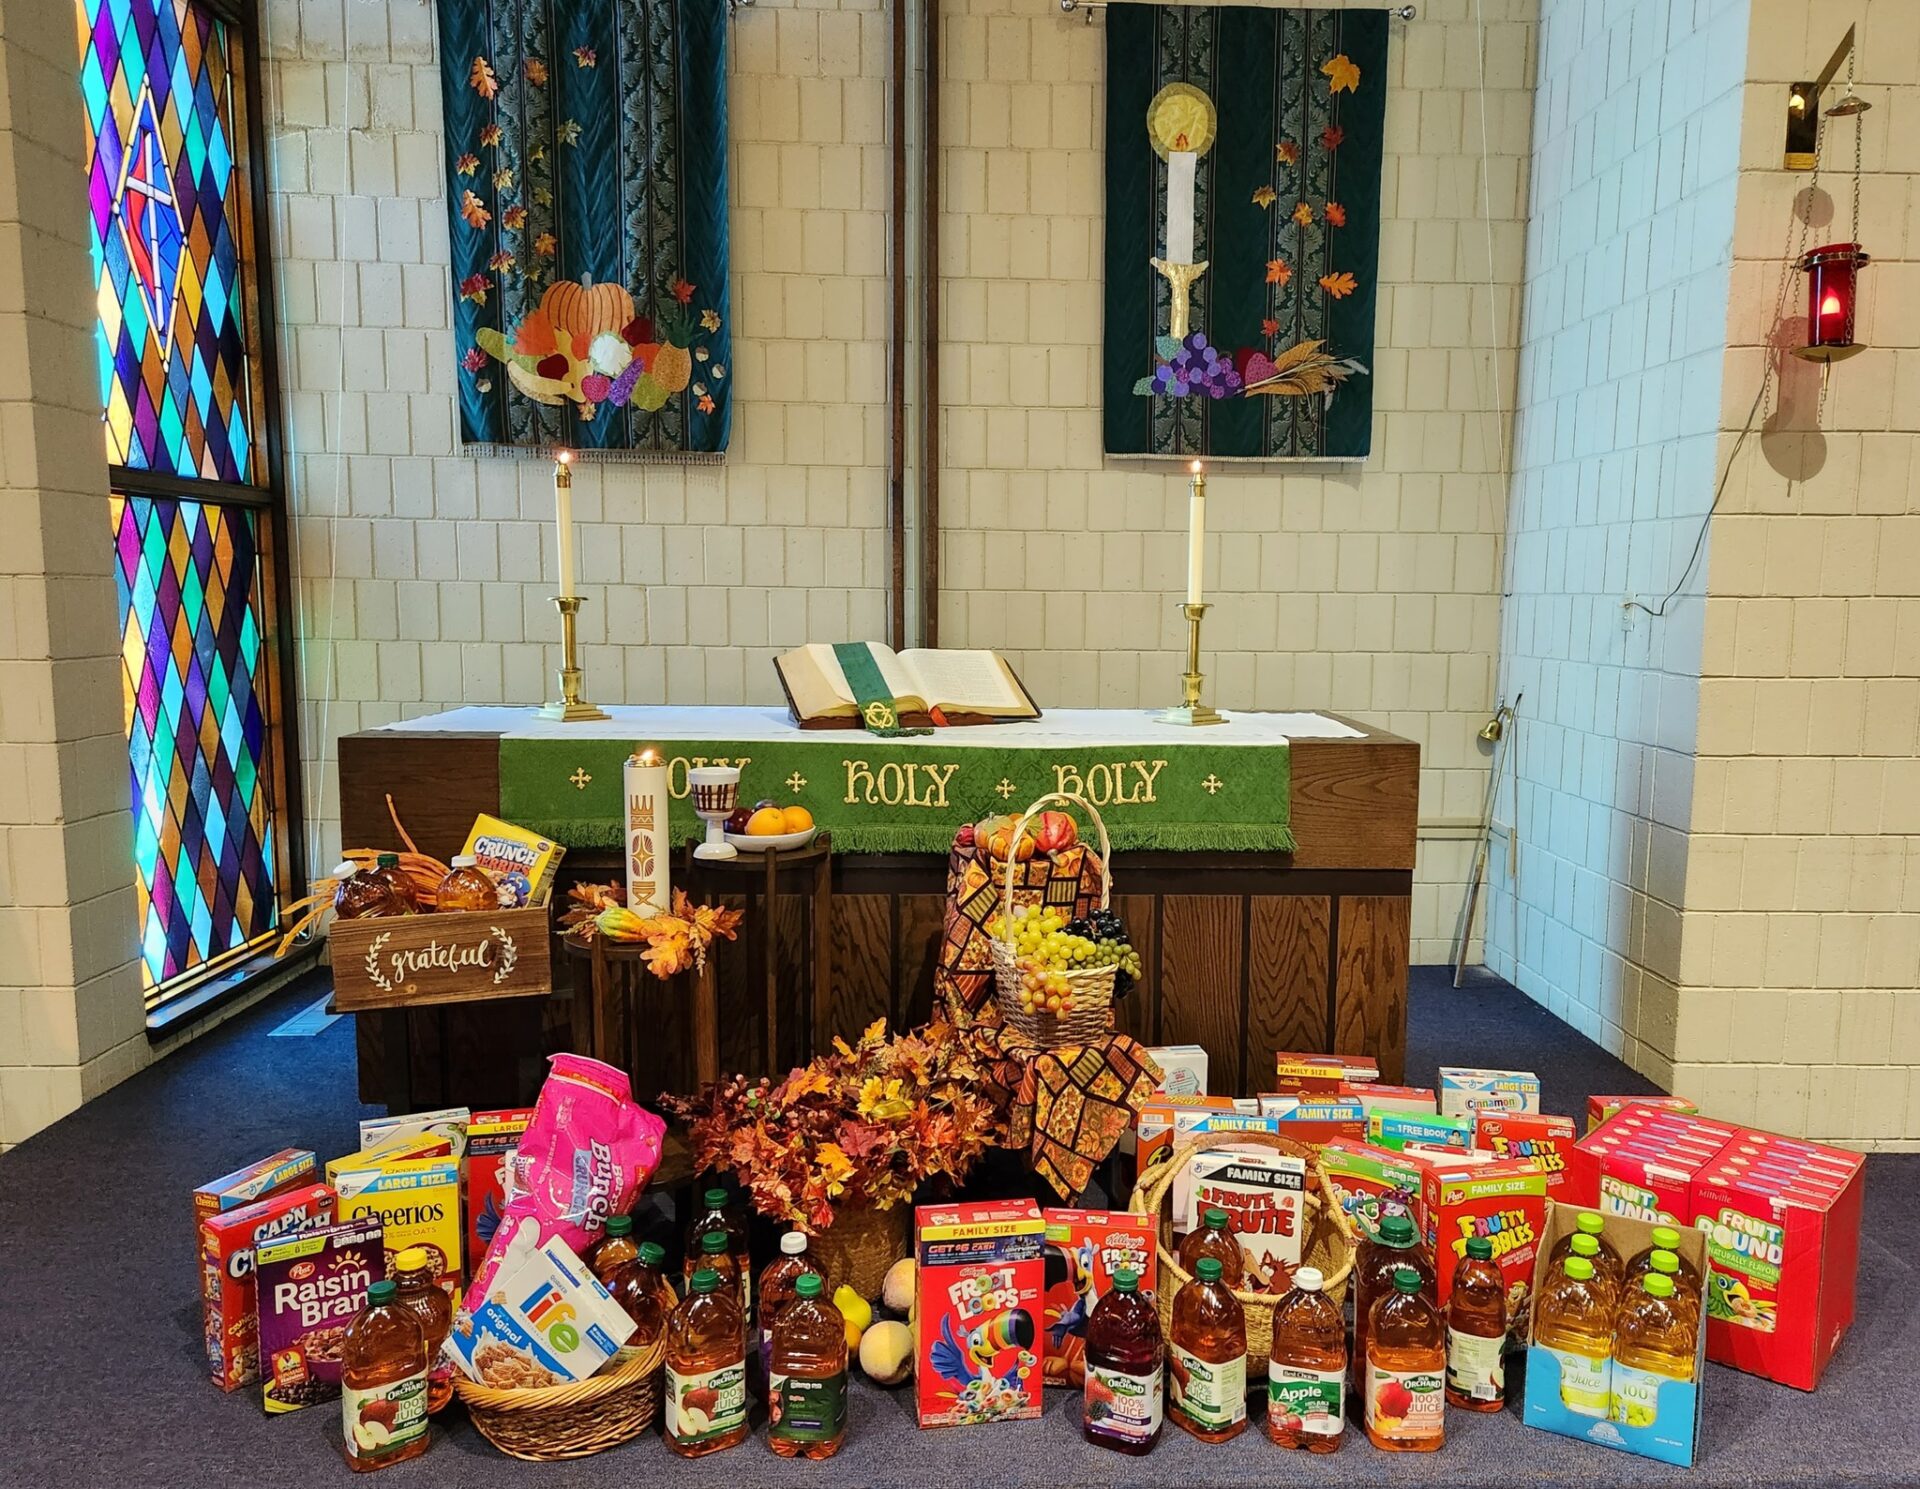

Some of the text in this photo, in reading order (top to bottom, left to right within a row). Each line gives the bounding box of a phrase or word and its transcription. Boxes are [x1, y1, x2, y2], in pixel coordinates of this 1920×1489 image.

[842, 760, 959, 808] HOLY
[474, 837, 540, 867] CRUNCH
[391, 939, 492, 983] grateful
[1280, 1066, 1327, 1076] FAMILY SIZE
[1494, 1081, 1518, 1091] LARGE
[1520, 1082, 1537, 1092] SIZE
[1466, 1097, 1515, 1109] Cinnamon
[1296, 1107, 1353, 1119] FAMILY SIZE
[493, 1124, 525, 1132] LARGE
[1208, 1119, 1267, 1131] FAMILY SIZE
[1403, 1125, 1423, 1136] FREE
[1424, 1128, 1447, 1139] BOOK
[273, 1157, 314, 1184] LARGE SIZE
[1226, 1166, 1302, 1187] FAMILY SIZE
[377, 1173, 447, 1191] LARGE SIZE
[584, 1137, 613, 1232] Bunch
[609, 1162, 624, 1214] Berry
[1471, 1181, 1526, 1194] FAMILY SIZE
[1211, 1187, 1276, 1210] FRUTE
[1446, 1190, 1464, 1203] Post
[1601, 1177, 1653, 1207] FRUIT
[1698, 1189, 1733, 1204] Millville
[253, 1203, 308, 1242] CAP'N
[352, 1201, 445, 1228] Cheerios
[1456, 1208, 1525, 1238] FRUITY
[953, 1225, 1017, 1237] FAMILY SIZE
[1721, 1210, 1781, 1243] FRUIT
[928, 1244, 955, 1254] GET
[1101, 1248, 1149, 1264] FROOT
[274, 1268, 371, 1315] Raisin
[947, 1268, 1016, 1306] FROOT
[301, 1290, 369, 1328] Bran
[956, 1287, 1019, 1321] LOOPS
[486, 1307, 523, 1344] original
[519, 1281, 580, 1354] life
[1108, 1379, 1145, 1394] ORCHARD
[1279, 1386, 1322, 1402] Apple
[1404, 1380, 1441, 1390] ORCHARD
[1113, 1404, 1145, 1417] JUICE
[1118, 1396, 1144, 1409] 100%
[1409, 1403, 1441, 1413] JUICE
